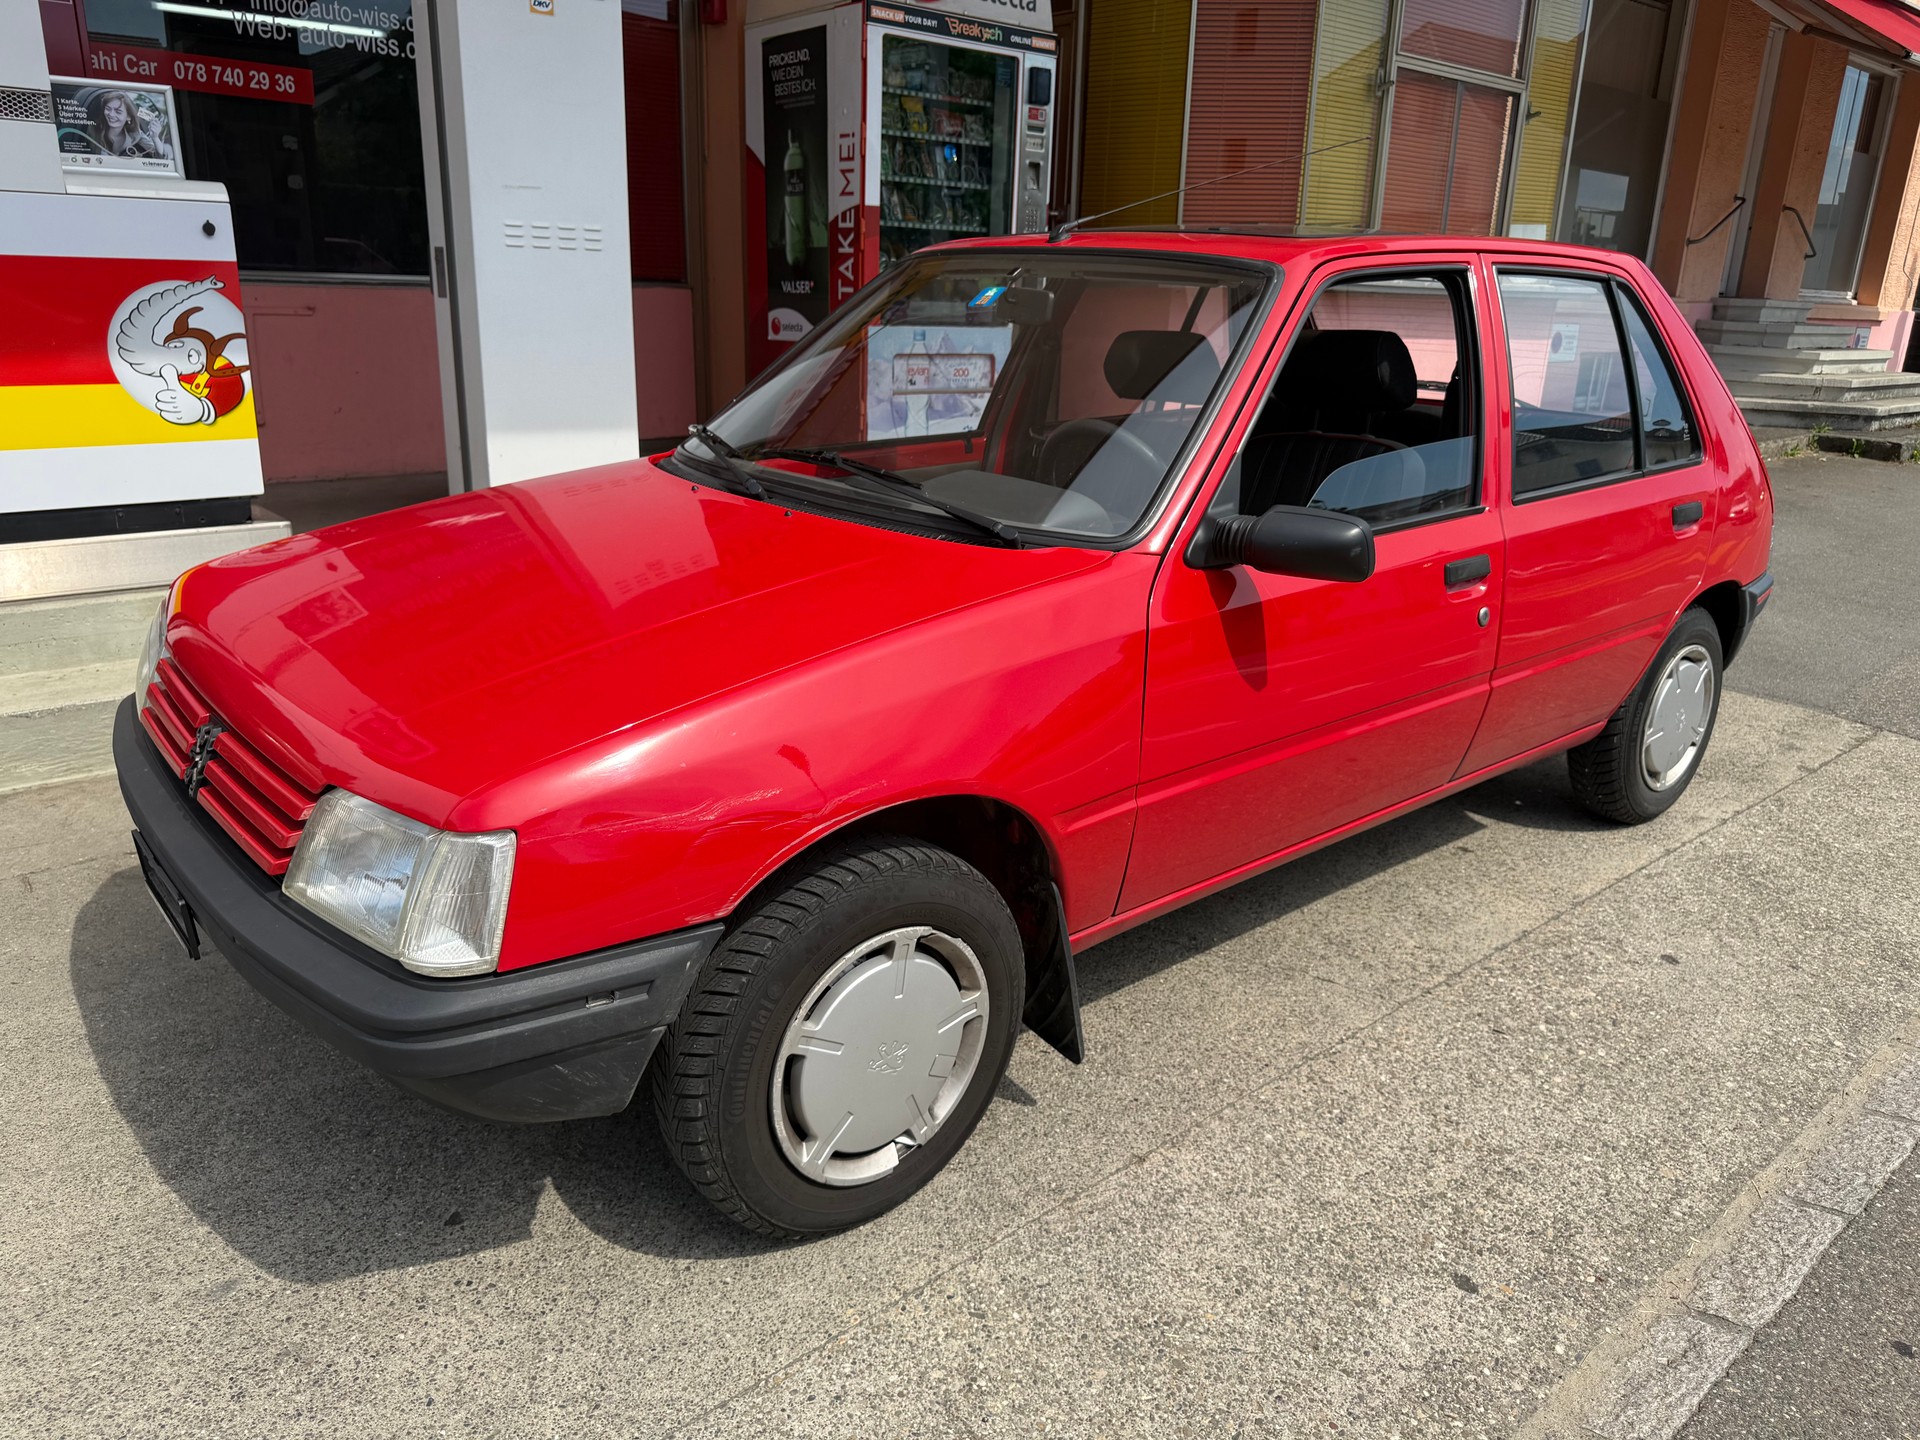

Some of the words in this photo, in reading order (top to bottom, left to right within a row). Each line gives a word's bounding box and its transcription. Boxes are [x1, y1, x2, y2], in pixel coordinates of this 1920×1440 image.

[533, 0, 550, 8] DKV
[231, 9, 292, 41] Web:
[905, 15, 922, 25] YOUR
[922, 18, 939, 28] DAY!
[768, 48, 811, 68] PRICKELND,
[123, 54, 157, 76] Car
[174, 60, 207, 82] 078
[211, 65, 244, 87] 740
[249, 70, 270, 90] 29
[274, 74, 296, 94] 36
[771, 67, 786, 82] WIE
[786, 64, 804, 79] DEIN
[774, 79, 801, 97] BESTES
[60, 117, 97, 126] Tankstellen.
[839, 131, 856, 197] ME!
[838, 208, 855, 301] TAKE
[781, 279, 812, 294] VALSER
[782, 321, 803, 333] selecta
[953, 367, 970, 378] 200
